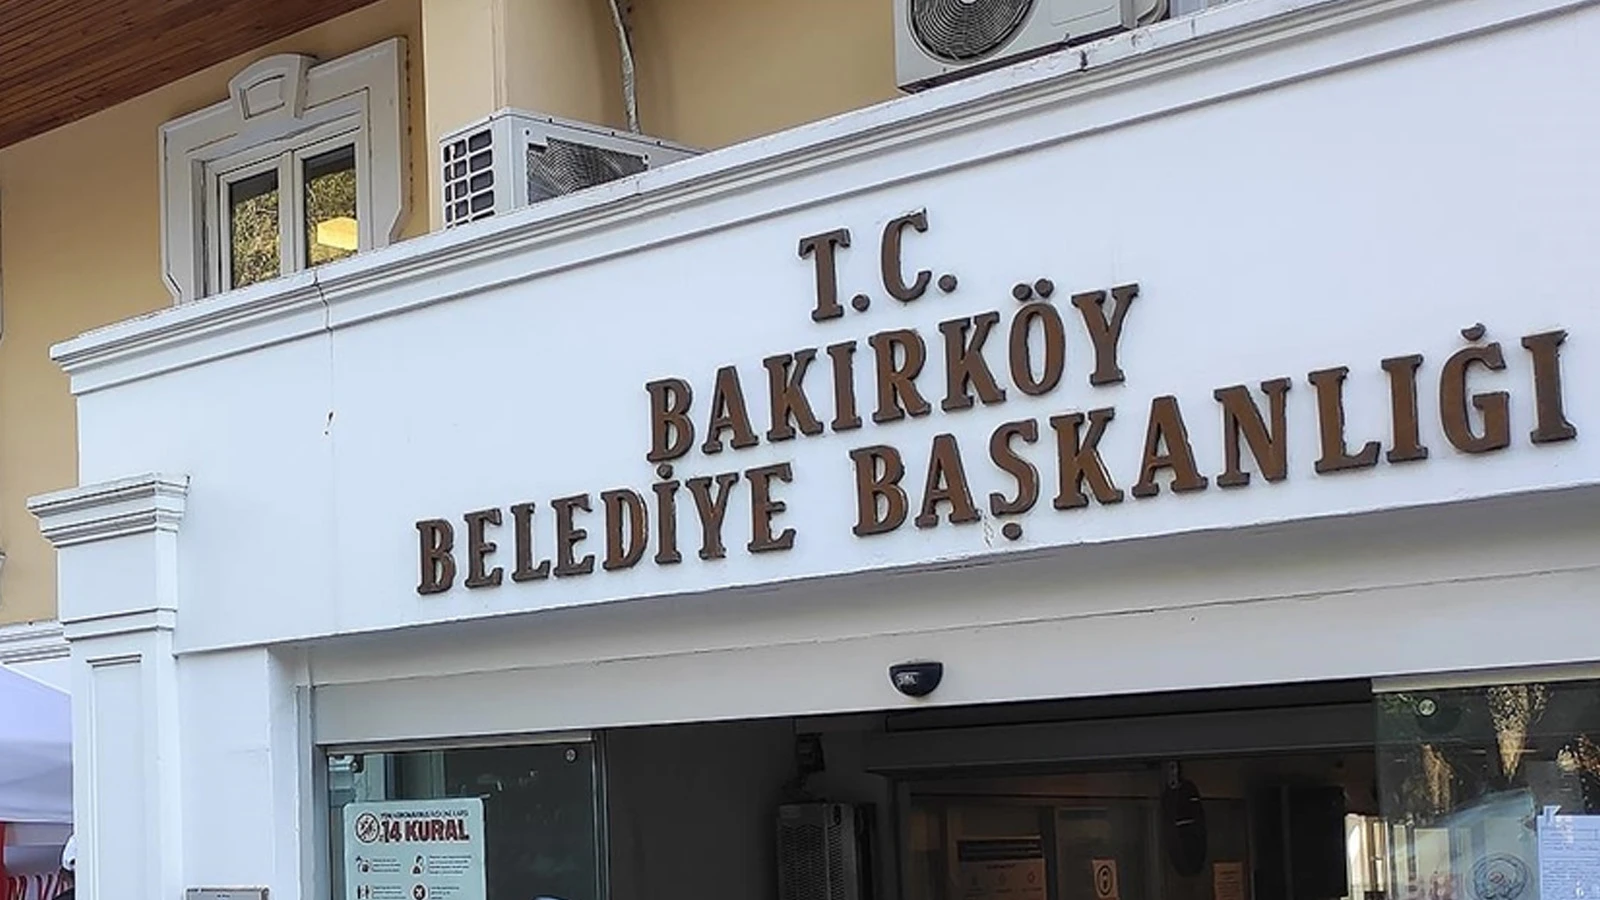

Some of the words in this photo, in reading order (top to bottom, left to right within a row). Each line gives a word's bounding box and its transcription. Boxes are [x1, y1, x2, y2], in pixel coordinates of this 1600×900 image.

[799, 208, 957, 323] T.C.
[646, 279, 1139, 462] BAKIRKÖY
[416, 462, 796, 597] BELEDİYE
[849, 323, 1577, 541] BAŞKANLIĞI
[380, 820, 403, 842] 14
[404, 818, 471, 842] KURAL
